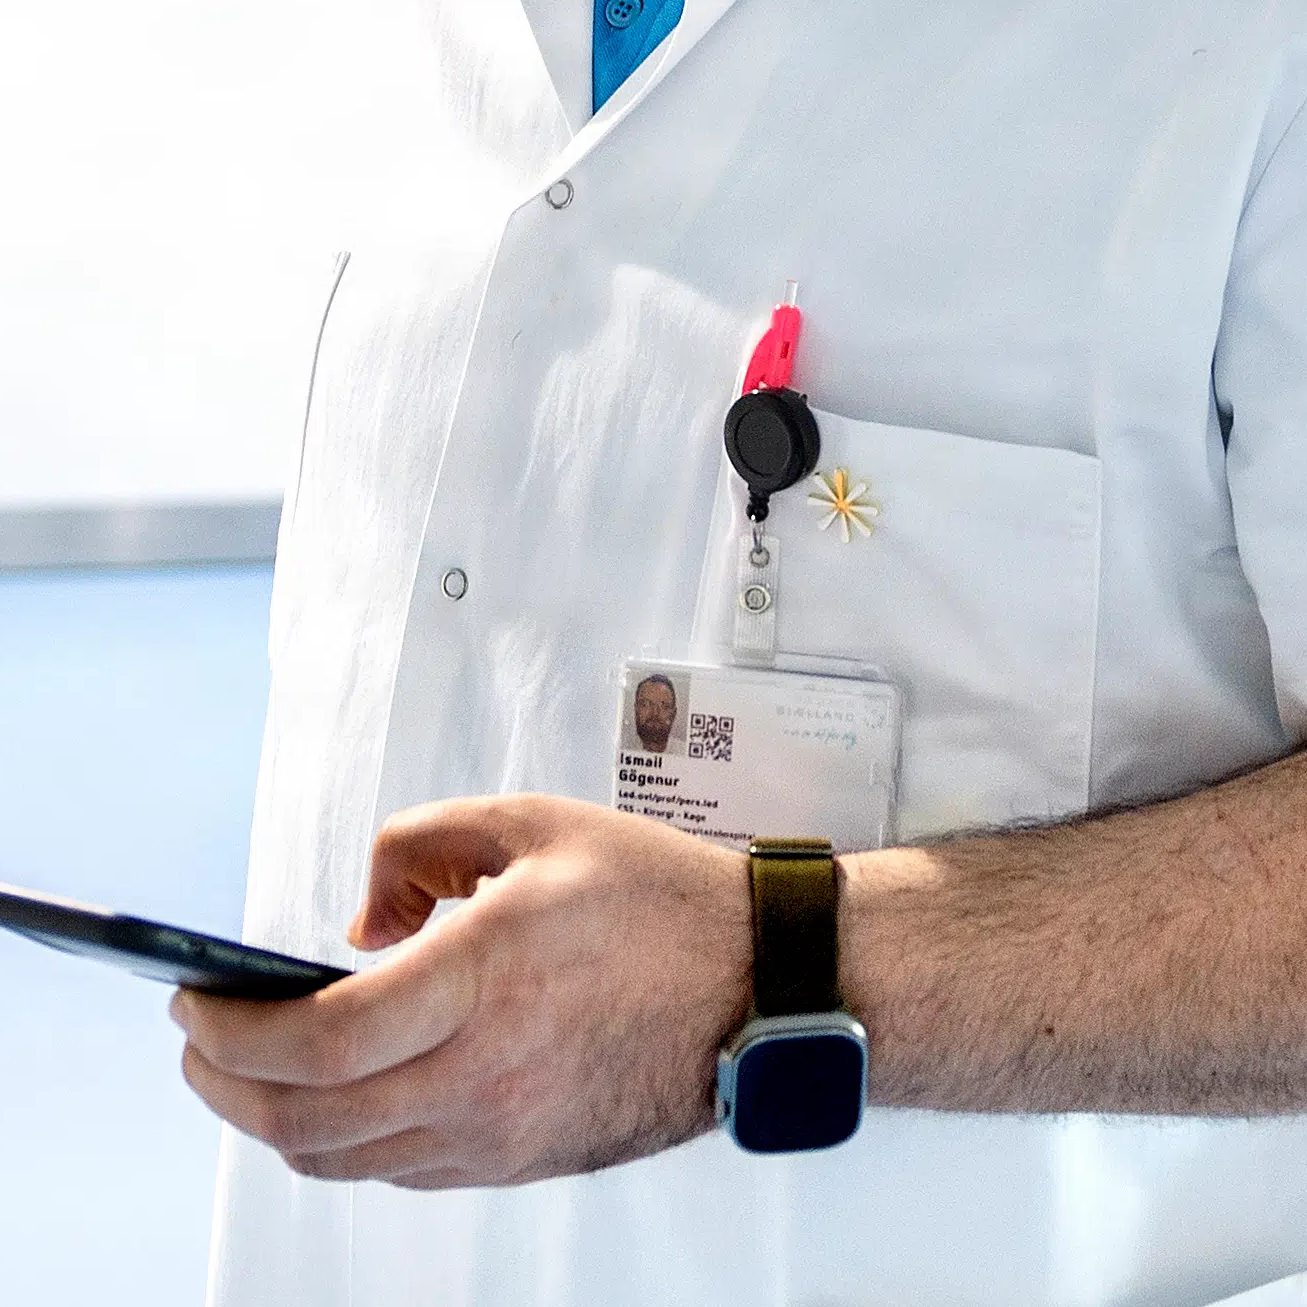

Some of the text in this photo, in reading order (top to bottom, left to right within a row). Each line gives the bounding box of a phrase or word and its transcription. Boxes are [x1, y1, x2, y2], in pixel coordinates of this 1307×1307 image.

[619, 752, 663, 768] Ismail
[618, 768, 680, 787] Gögenur
[643, 807, 675, 820] Kirurgi
[683, 811, 706, 824] Køge
